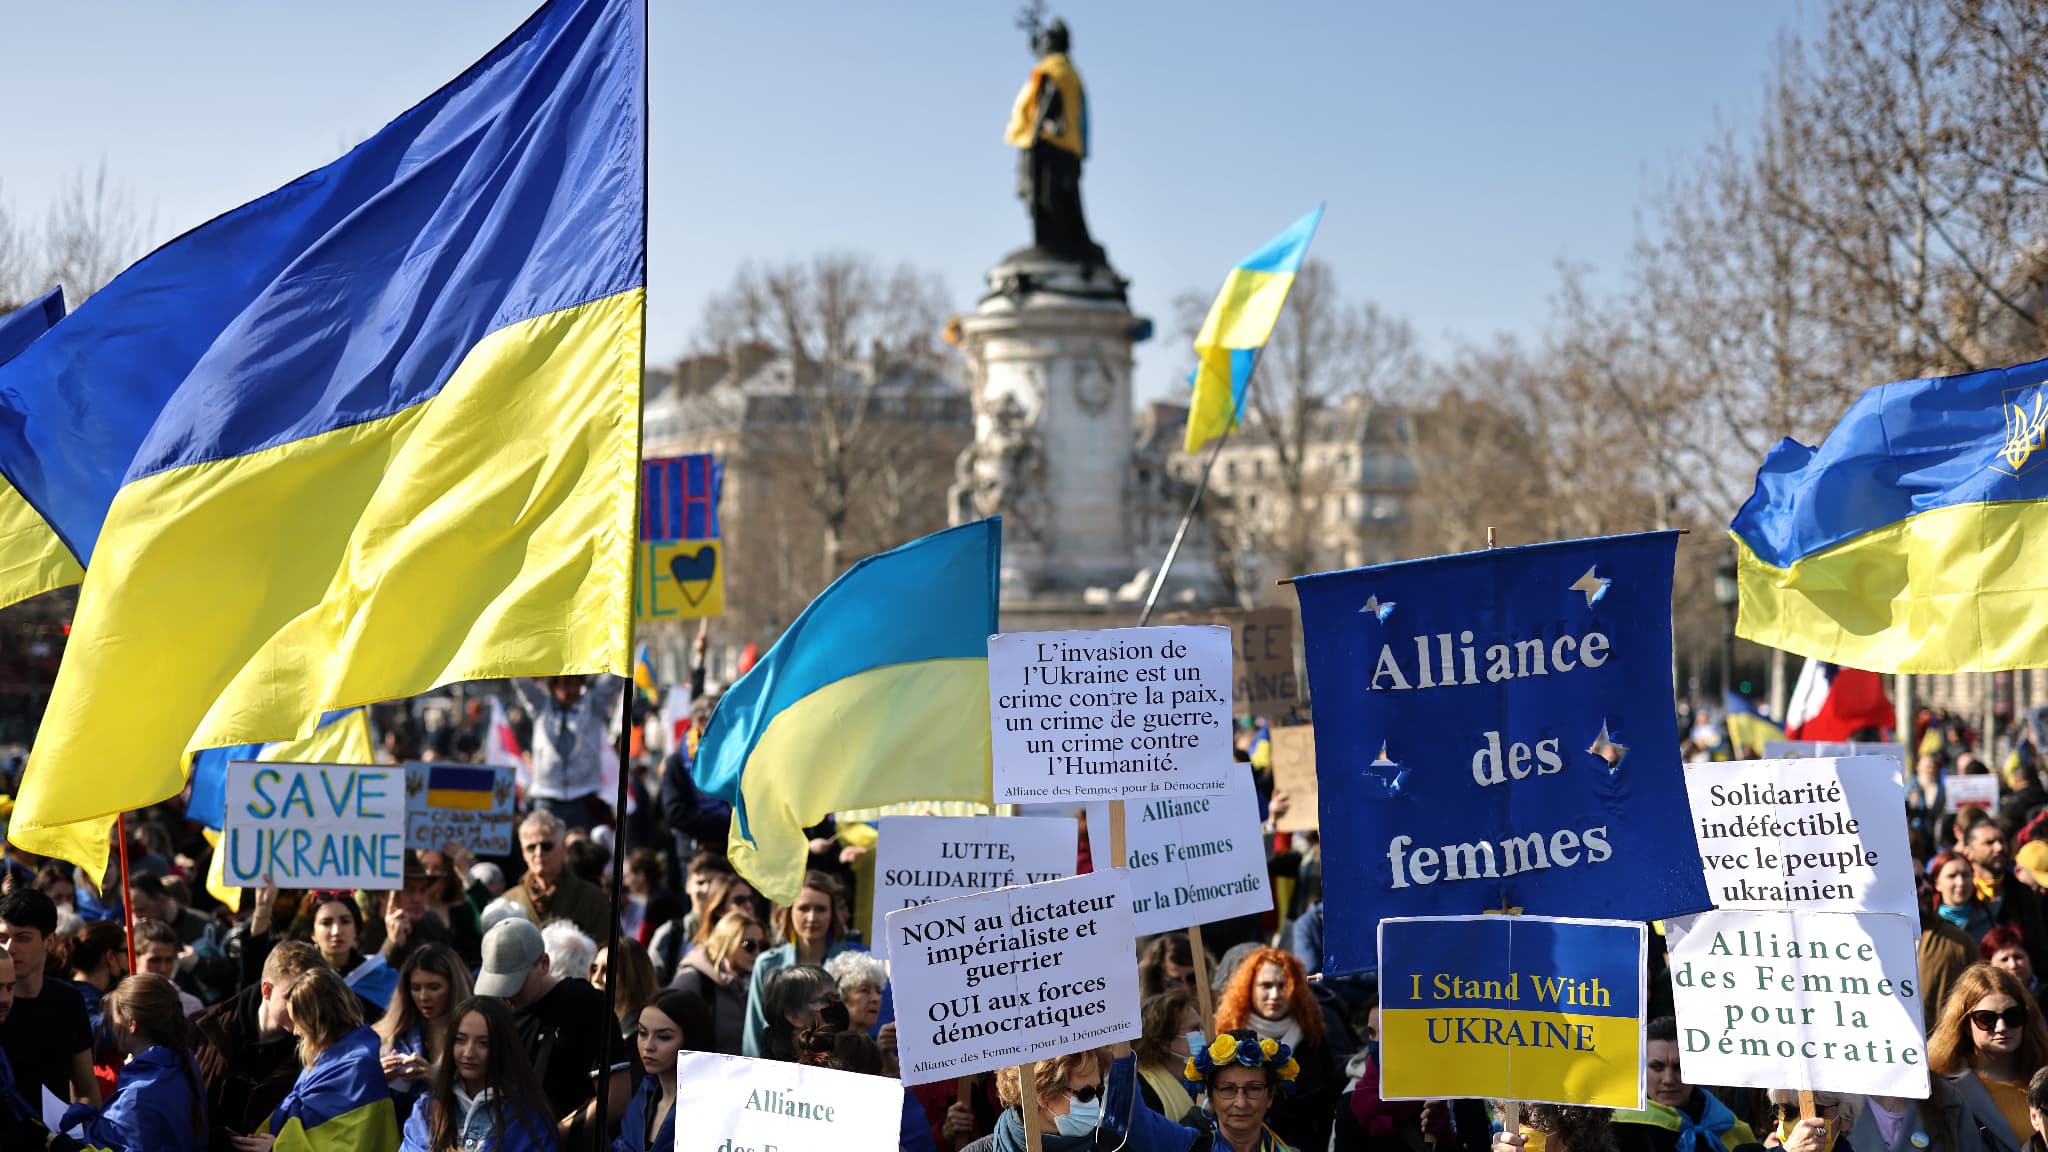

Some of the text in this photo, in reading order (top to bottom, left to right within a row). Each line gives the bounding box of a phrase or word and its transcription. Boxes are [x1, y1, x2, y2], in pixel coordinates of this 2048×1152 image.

[642, 455, 713, 540] ITH
[1037, 639, 1187, 663] L'invasion de
[1366, 630, 1610, 691] Alliance
[1136, 666, 1167, 682] est
[1174, 666, 1201, 681] un
[999, 684, 1226, 711] crime contre la paix,
[1005, 710, 1219, 733] un crime de guerre,
[1027, 732, 1199, 754] un crime contre
[1472, 731, 1563, 787] des
[246, 768, 390, 819] SAVE
[1005, 780, 1225, 797] Alliance des Femmes pour la Démocratie
[1711, 781, 1841, 807] Solidarité
[1142, 798, 1210, 822] Alliance
[1701, 812, 1859, 838] indéfectible
[231, 828, 401, 881] UKRAINE
[941, 840, 1016, 862] LUTTE,
[1129, 838, 1233, 869] des Femmes
[1387, 825, 1613, 889] femmes
[1755, 847, 1777, 868] le
[1784, 844, 1878, 876] peuple
[885, 869, 1014, 888] SOLIDARITÉ
[1133, 873, 1260, 914] ur la Démocratie
[1723, 879, 1855, 901] ukrainien
[901, 893, 1115, 945] NON au dictateur
[927, 919, 1098, 965] impérialiste et
[1708, 930, 1873, 962] Alliance
[966, 951, 1063, 987] guerrier
[1676, 962, 1914, 998] des Femmes
[928, 976, 1107, 1022] OUI aux forces
[1409, 973, 1611, 1007] I Stand With
[932, 999, 1106, 1046] démocratiques
[1724, 1001, 1869, 1029] pour la
[913, 1057, 957, 1073] Alliance
[961, 1052, 979, 1065] des
[1031, 1039, 1056, 1053] pour
[1059, 1034, 1069, 1045] la
[1073, 1020, 1131, 1041] Démocratie
[1426, 1017, 1595, 1051] UKRAINE
[1684, 1028, 1919, 1065] Démocratie
[744, 1088, 835, 1123] Alliance
